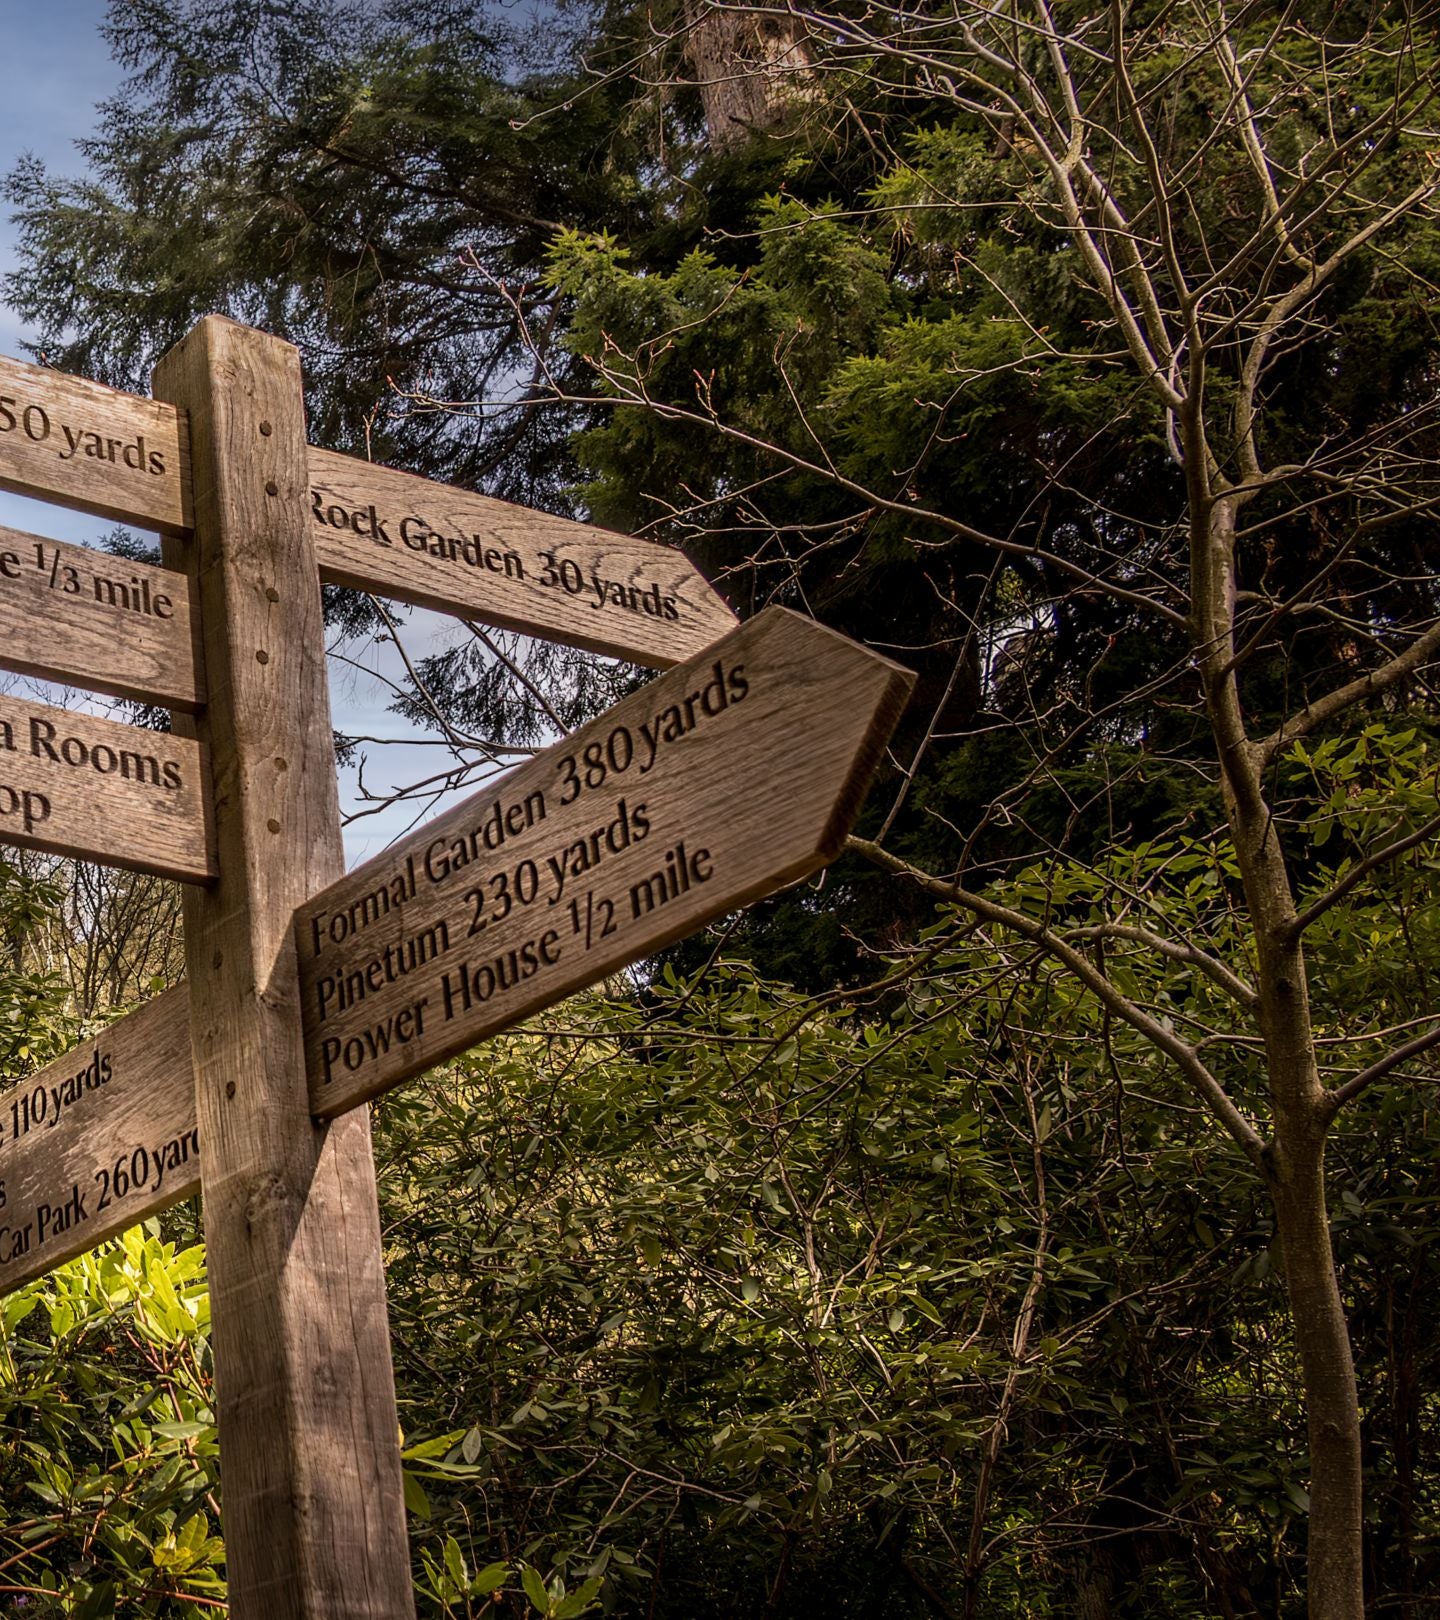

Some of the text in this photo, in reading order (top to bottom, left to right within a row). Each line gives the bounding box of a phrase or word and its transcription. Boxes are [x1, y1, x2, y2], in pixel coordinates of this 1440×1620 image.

[58, 424, 167, 476] yards
[95, 576, 174, 620] mile
[399, 516, 523, 579] Garden
[537, 552, 583, 594] 30
[591, 575, 678, 620] yards
[29, 717, 182, 790] Rooms
[312, 659, 750, 957] Formal Garden 380 yards
[316, 797, 651, 1022] Pinetum 230 yards
[320, 993, 427, 1084] Power
[441, 928, 560, 1020] House
[629, 840, 714, 920] mile
[10, 1085, 47, 1139] 110
[49, 1049, 112, 1127] yards
[36, 1184, 89, 1246] Park
[94, 1146, 149, 1212] 260
[151, 1126, 200, 1193] yar
